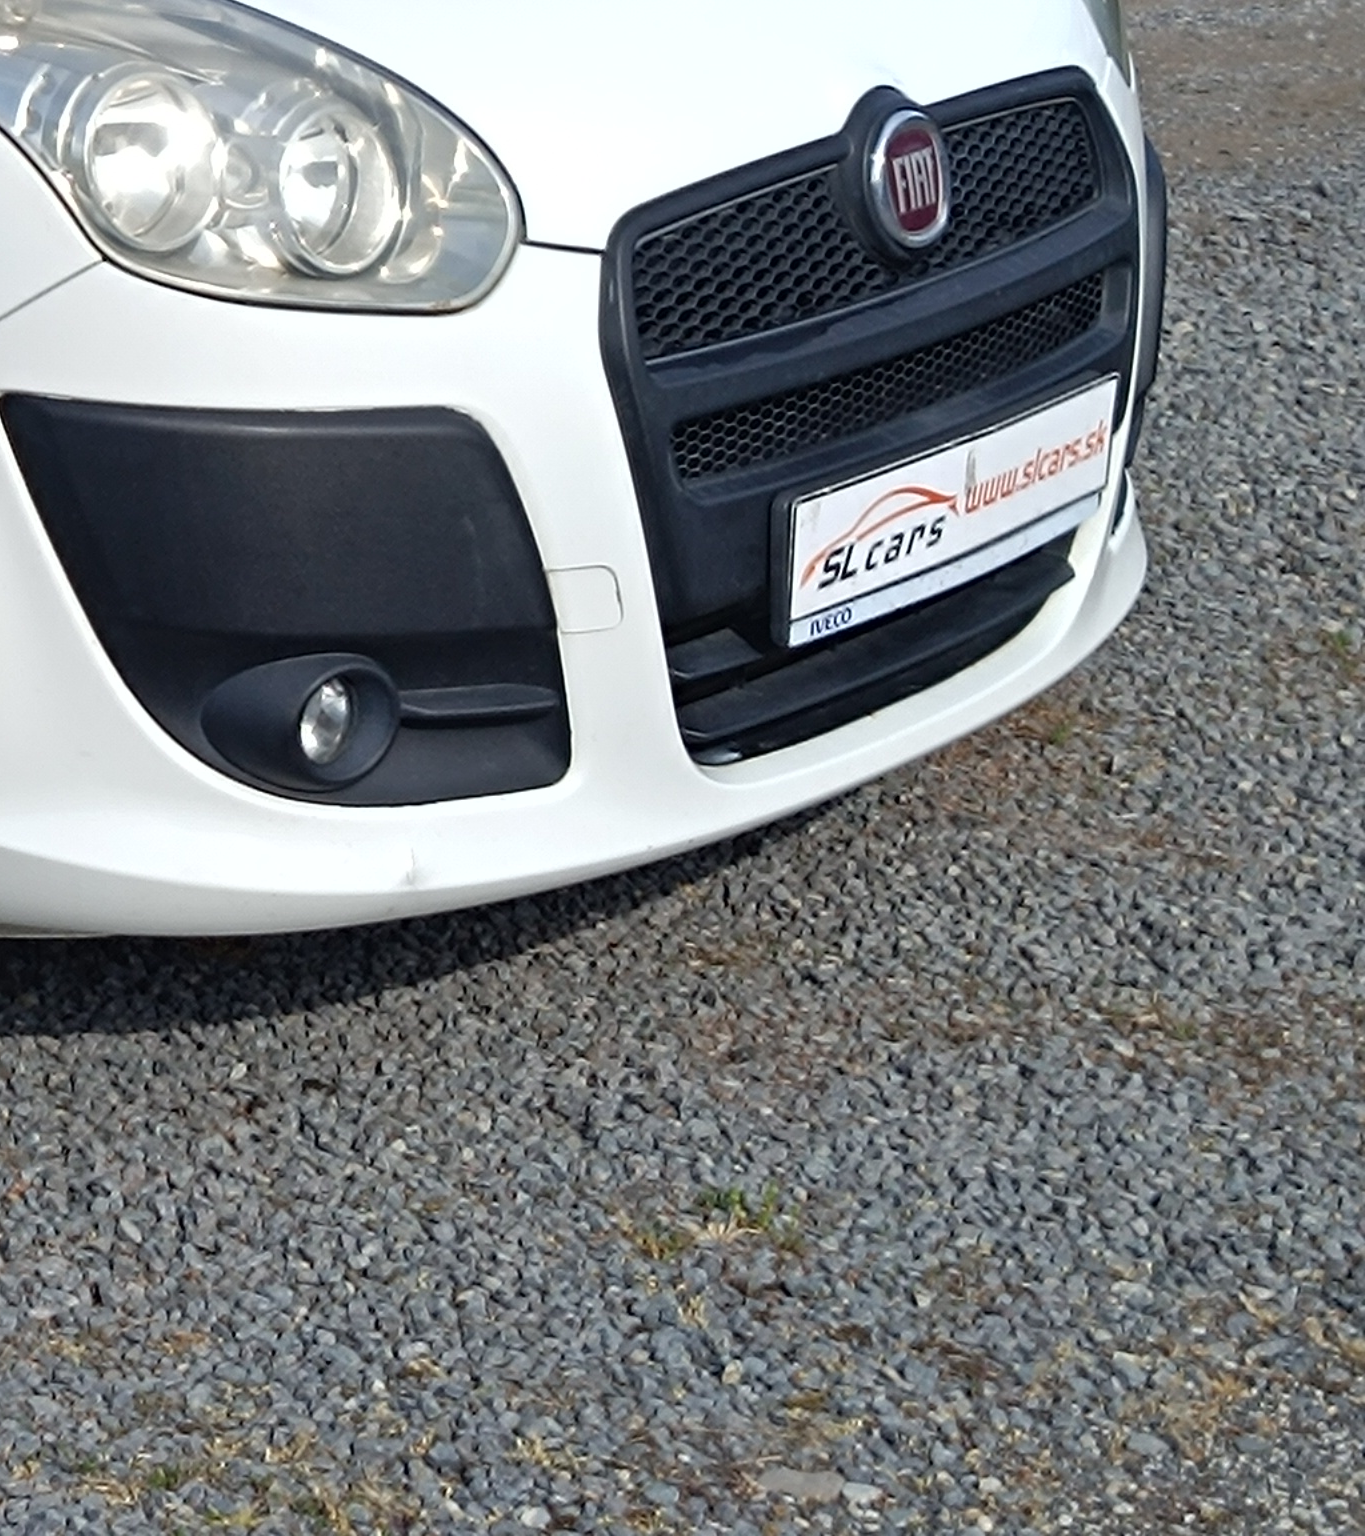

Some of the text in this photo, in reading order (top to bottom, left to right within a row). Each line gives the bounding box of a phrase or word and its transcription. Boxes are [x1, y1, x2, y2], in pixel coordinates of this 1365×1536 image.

[892, 145, 937, 213] FIAT
[965, 419, 1107, 513] www.slcars.sk
[810, 607, 852, 636] IVECO
